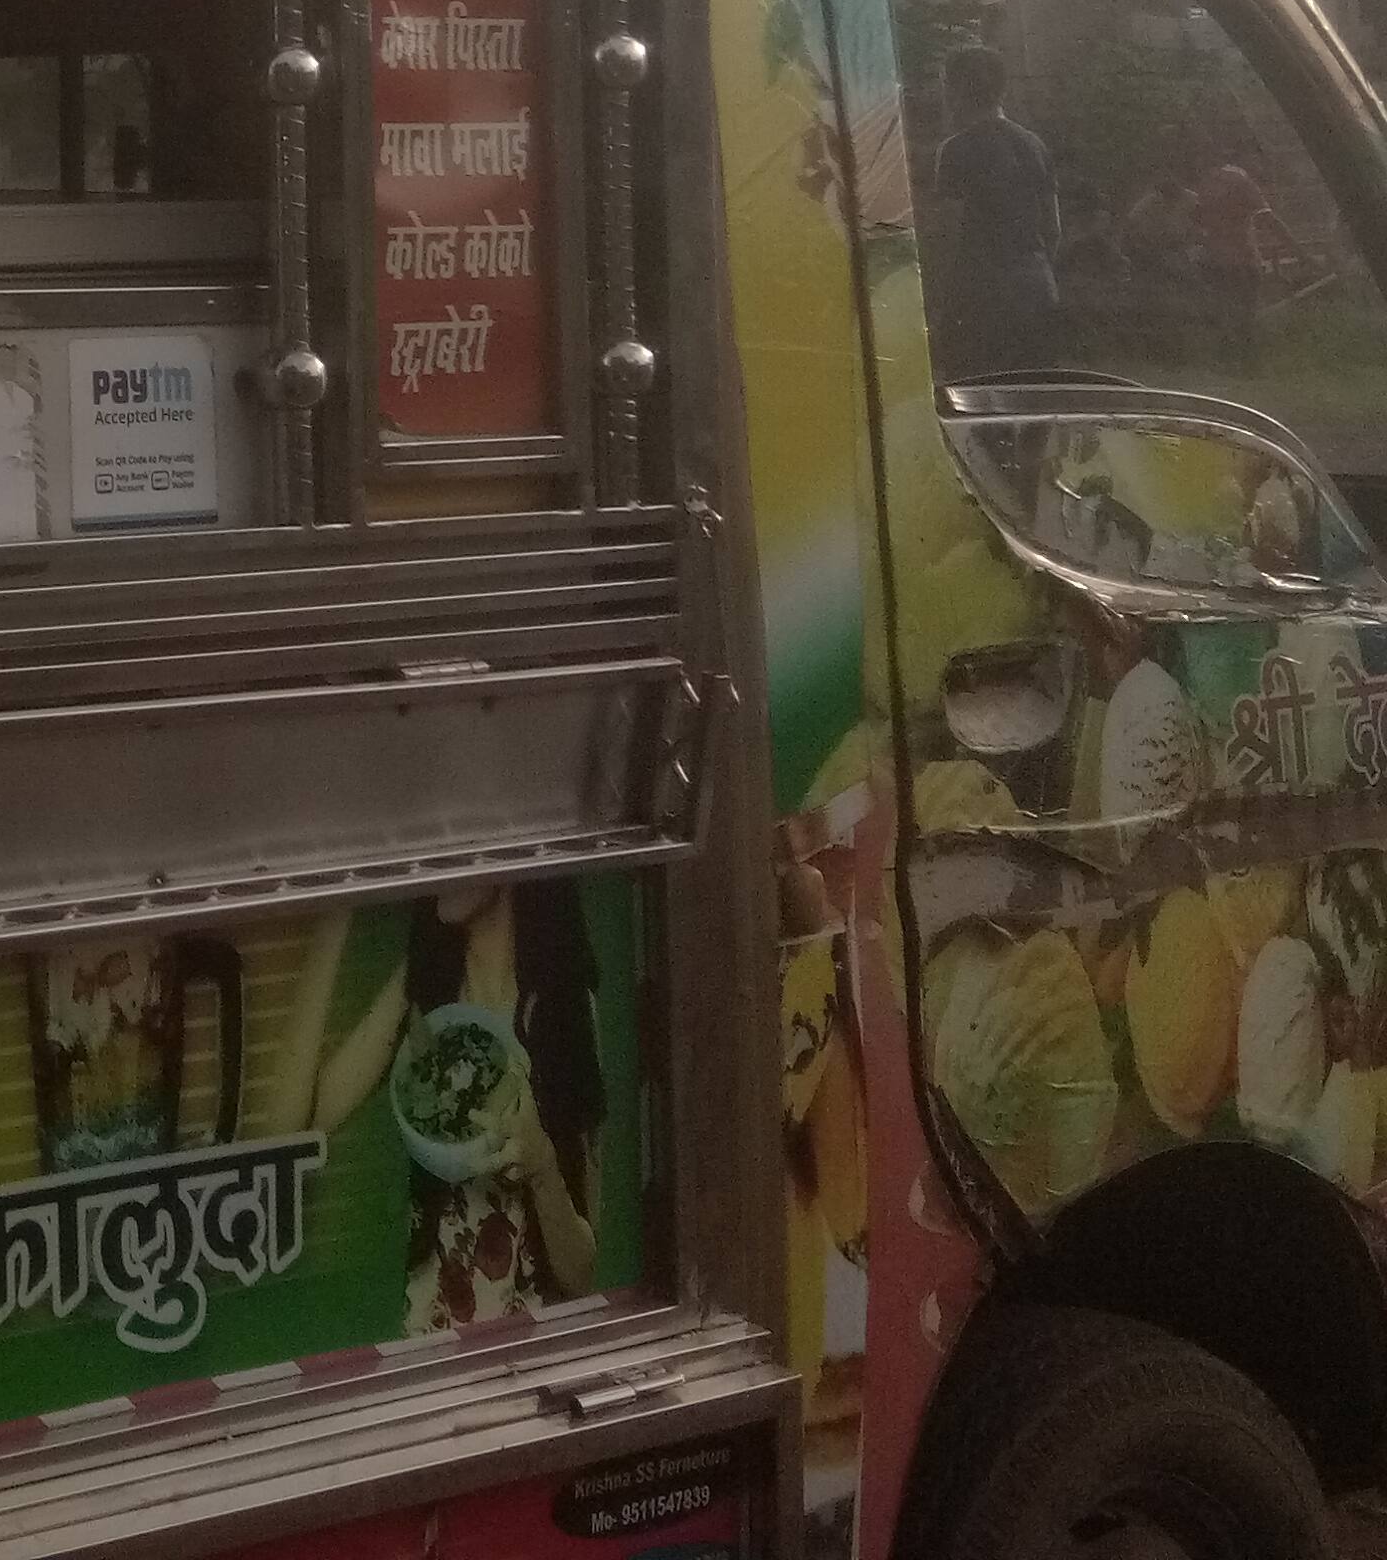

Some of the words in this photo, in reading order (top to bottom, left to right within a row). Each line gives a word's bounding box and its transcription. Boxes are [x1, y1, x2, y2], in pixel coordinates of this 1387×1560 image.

[445, 0, 525, 71] पिस्ता
[381, 122, 444, 177] मावा
[450, 107, 531, 181] मलाई
[386, 211, 458, 280] कोल्ड
[463, 209, 534, 278] कोको
[390, 304, 493, 394] स्ट्राबेरी
[94, 408, 158, 427] Accepted
[161, 407, 194, 422] Here
[95, 456, 114, 466] Scan
[1225, 650, 1319, 786] श्री
[1327, 650, 1387, 788] दे
[573, 1471, 631, 1499] Krishna
[635, 1460, 656, 1484] SS
[621, 1484, 711, 1526] 9511547839
